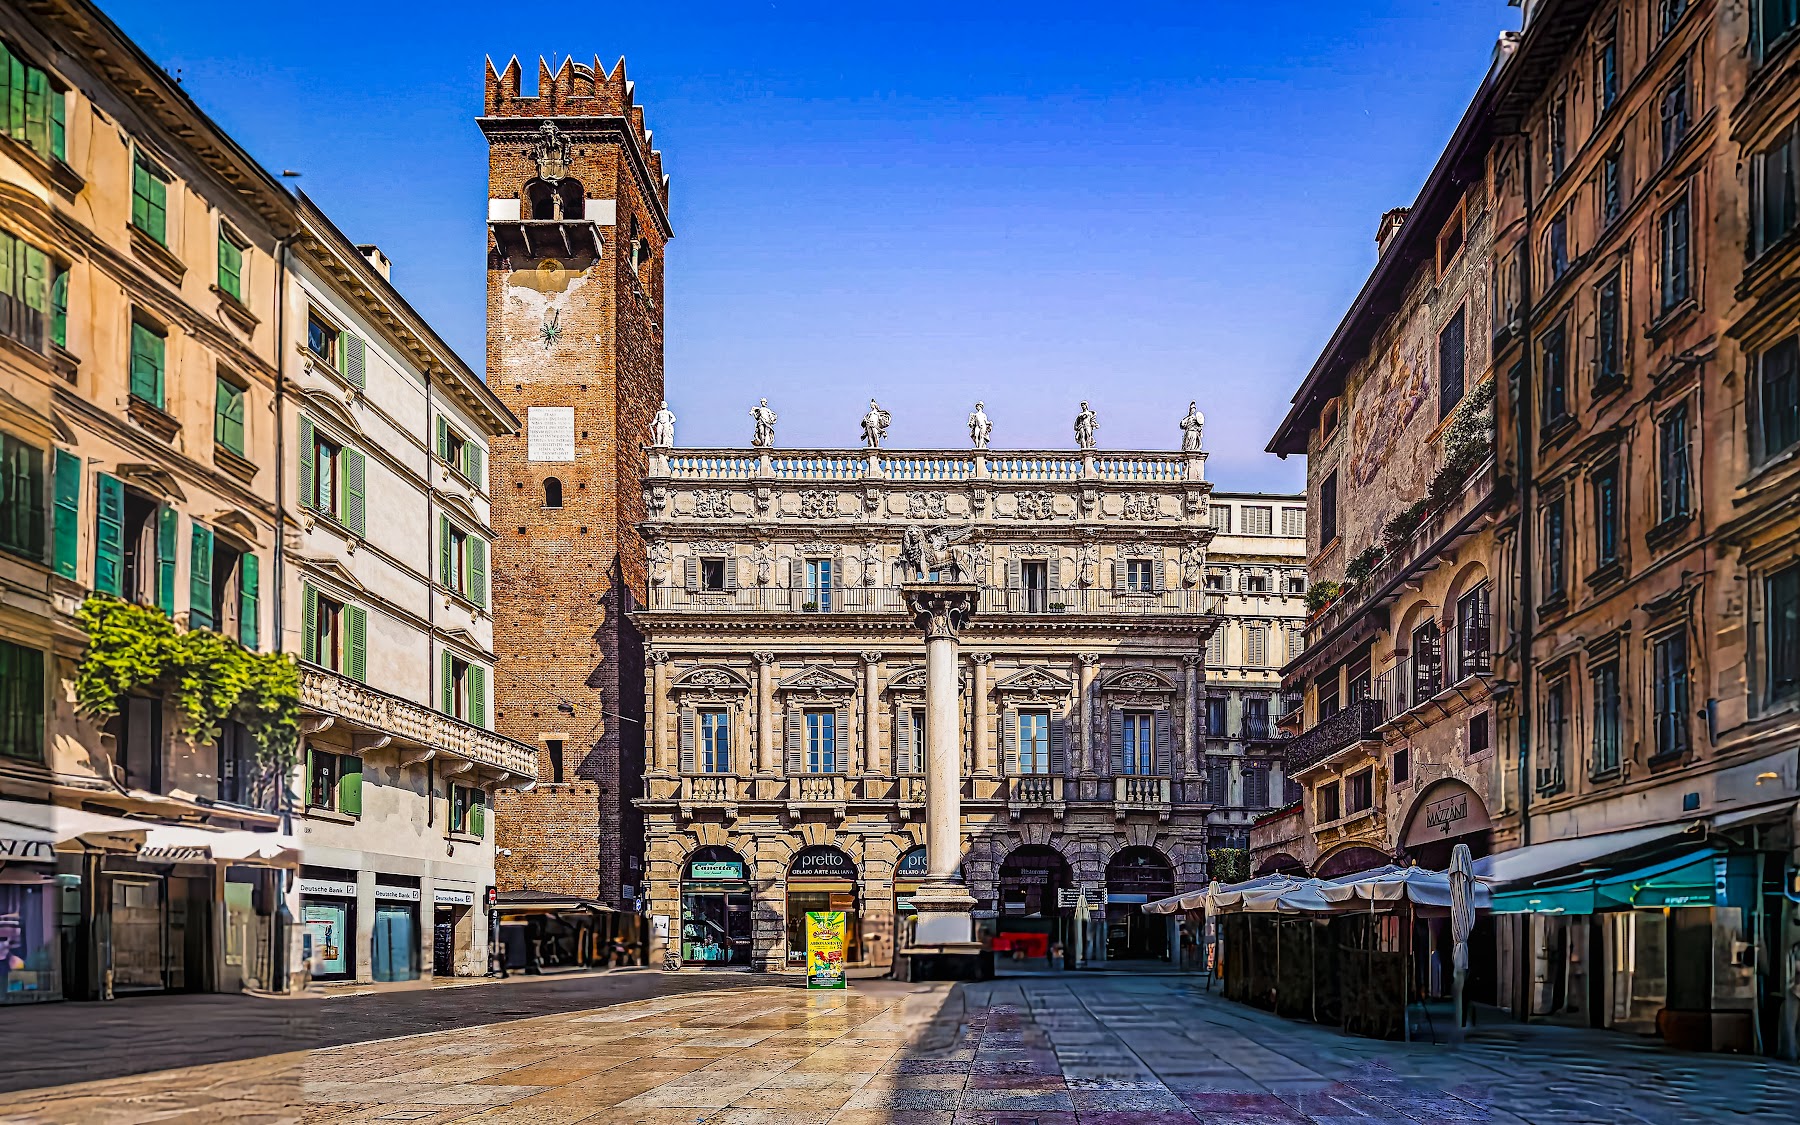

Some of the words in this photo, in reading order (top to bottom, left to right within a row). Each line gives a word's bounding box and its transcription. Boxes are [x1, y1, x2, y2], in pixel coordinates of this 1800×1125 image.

[802, 853, 843, 868] pretto
[300, 884, 328, 893] Deutsche
[329, 886, 343, 894] Bank
[375, 890, 398, 898] Deutsche
